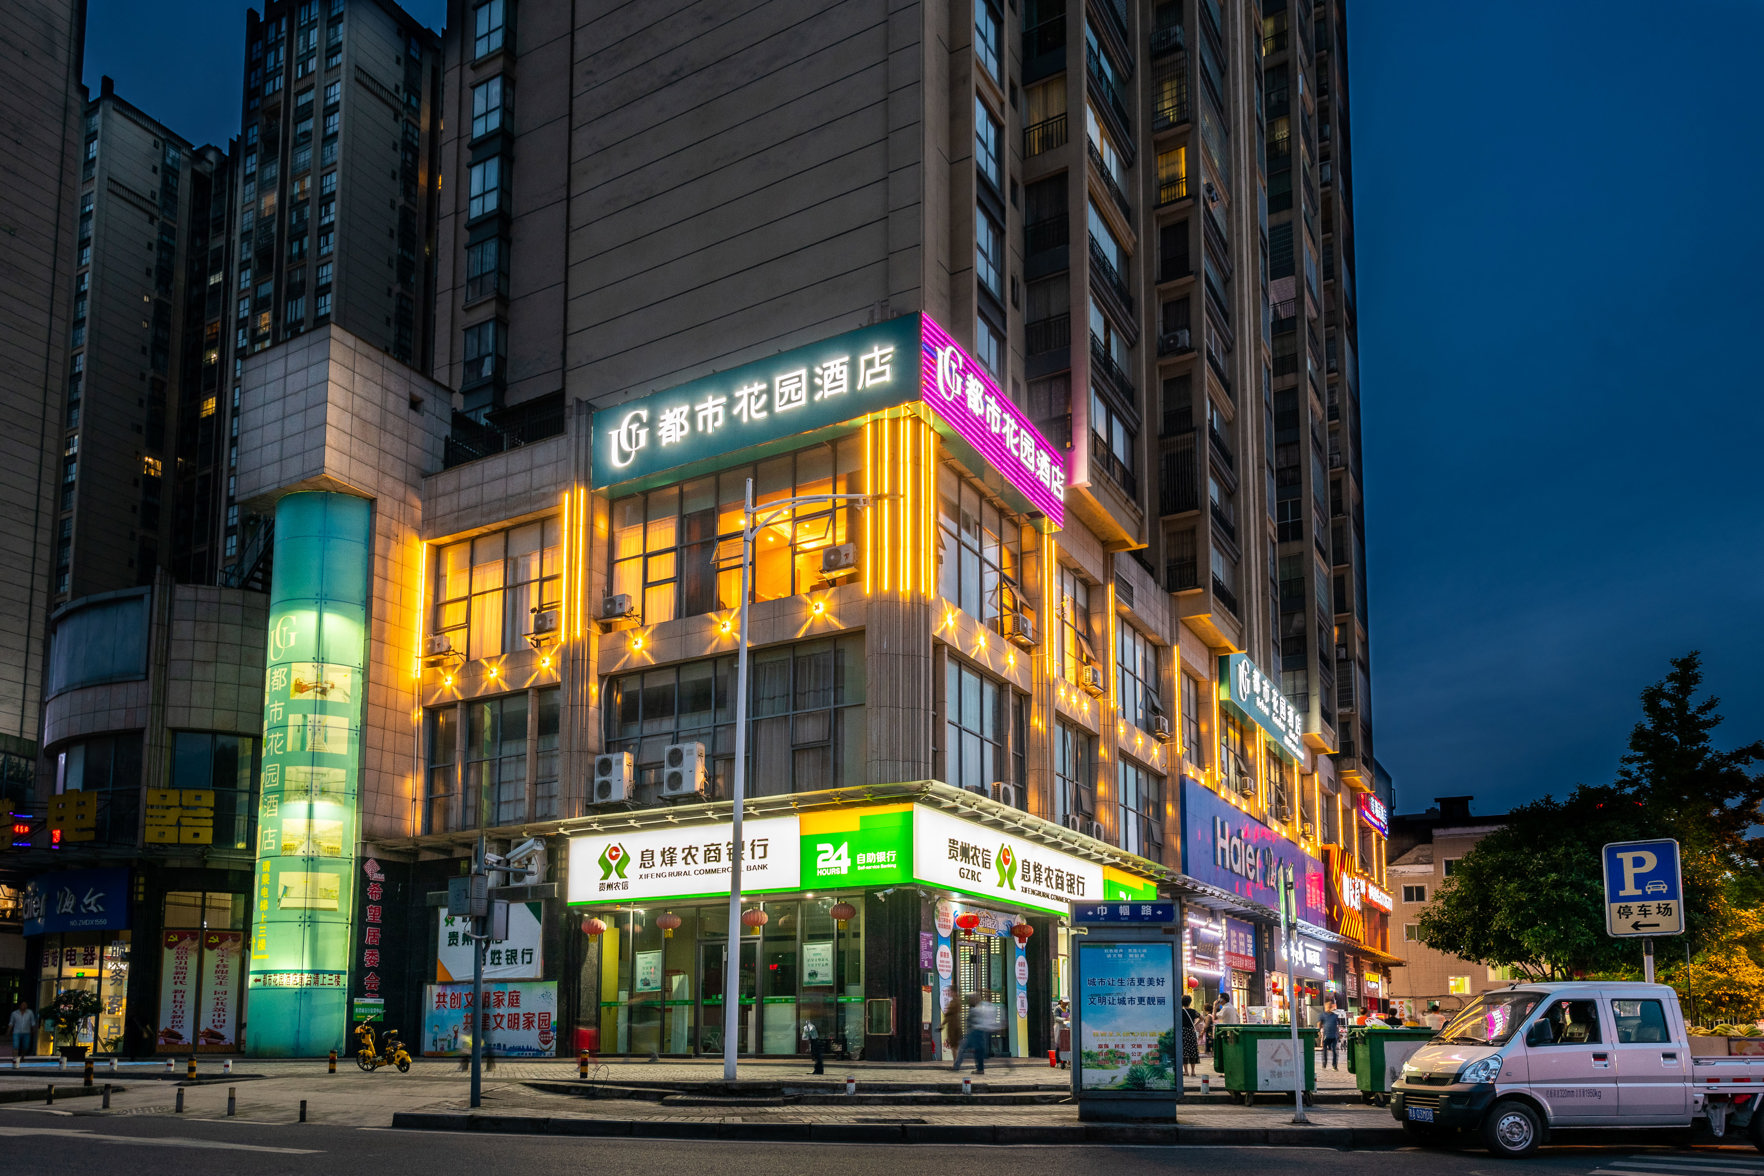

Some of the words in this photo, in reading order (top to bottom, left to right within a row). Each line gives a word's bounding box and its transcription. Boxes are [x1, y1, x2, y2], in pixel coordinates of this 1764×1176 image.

[657, 345, 895, 447] 都市花园酒店
[966, 372, 1065, 502] 都市花园酒店
[260, 667, 288, 851] 都市花园酒店
[638, 838, 769, 869] 息烽农商银行
[816, 841, 851, 875] 24
[856, 850, 897, 865] 自助银行
[947, 838, 992, 870] 贵州农信
[1214, 815, 1260, 883] Haier
[598, 880, 630, 892] 贵州农信
[638, 871, 667, 880] XIFENG
[668, 869, 693, 878] RURAL
[693, 865, 744, 876] COMMERC
[746, 863, 769, 872] BANK
[816, 867, 841, 876] HOURS
[958, 867, 982, 883] GZRC
[1020, 858, 1086, 897] 息烽农商银行
[1616, 850, 1658, 897] P
[1616, 902, 1673, 920] 停车场
[364, 882, 384, 999] 希望居委会
[107, 940, 129, 1042] 服务客户
[1087, 976, 1167, 988] 城市让生活更美好
[434, 990, 522, 1010] 共创文明家庭
[1087, 995, 1167, 1007] 文明让城市更靓丽
[462, 1011, 552, 1031] 共建文明家园
